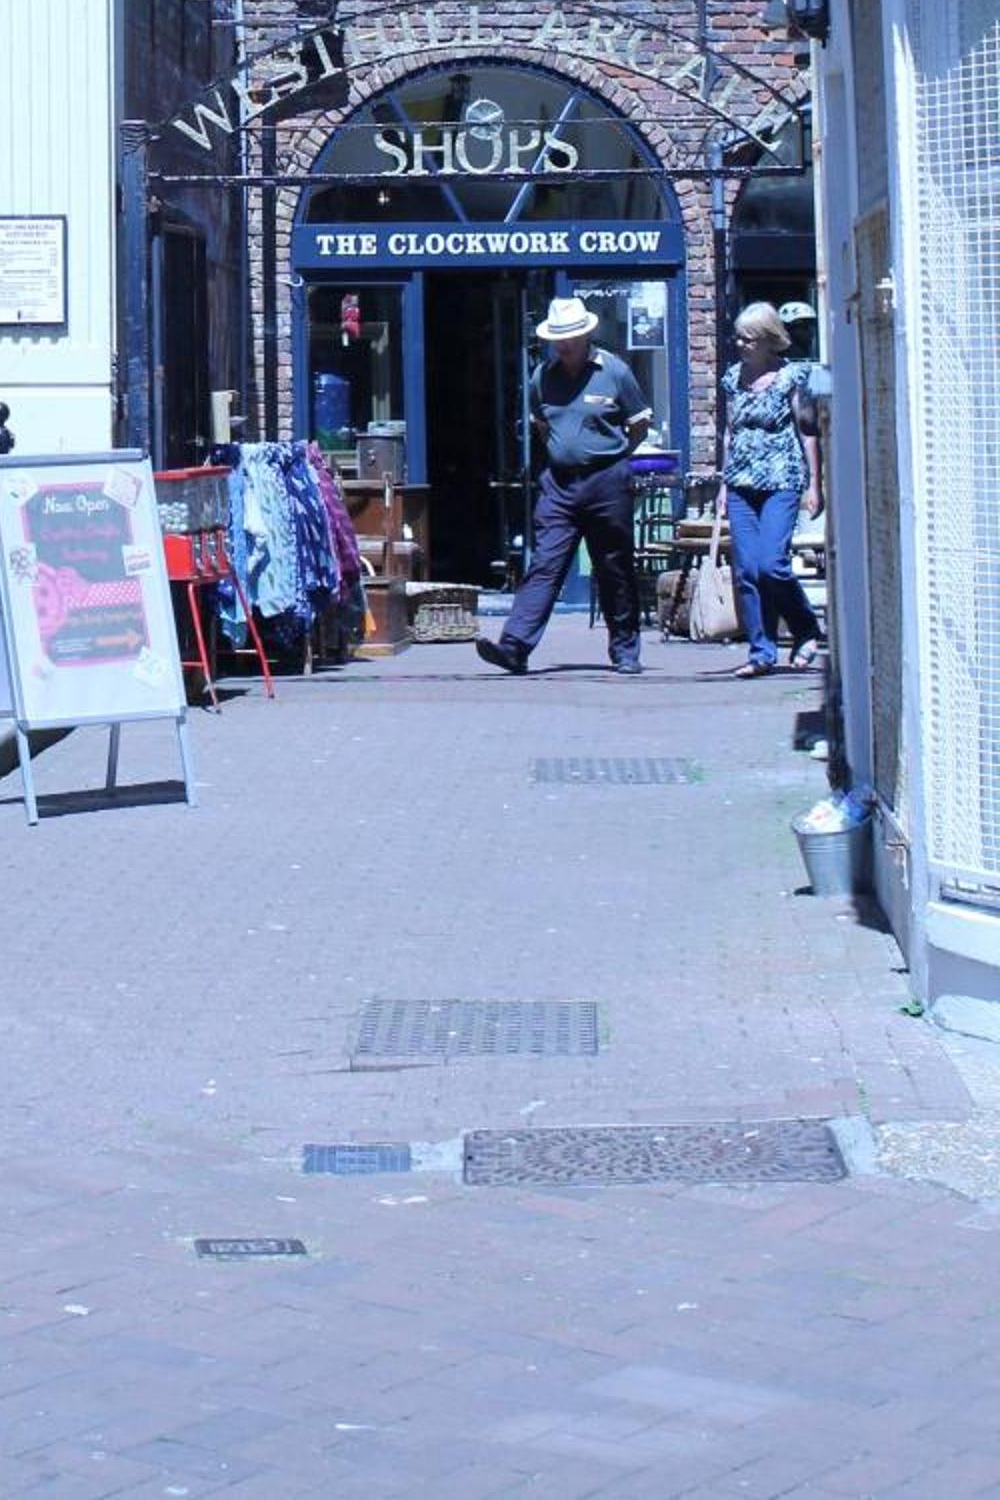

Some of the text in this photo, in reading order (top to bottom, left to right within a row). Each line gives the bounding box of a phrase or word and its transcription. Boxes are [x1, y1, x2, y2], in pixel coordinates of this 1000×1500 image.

[172, 23, 343, 151] WEST
[374, 128, 579, 175] SHOPS
[316, 230, 661, 256] THE CLOCKWORK CROW
